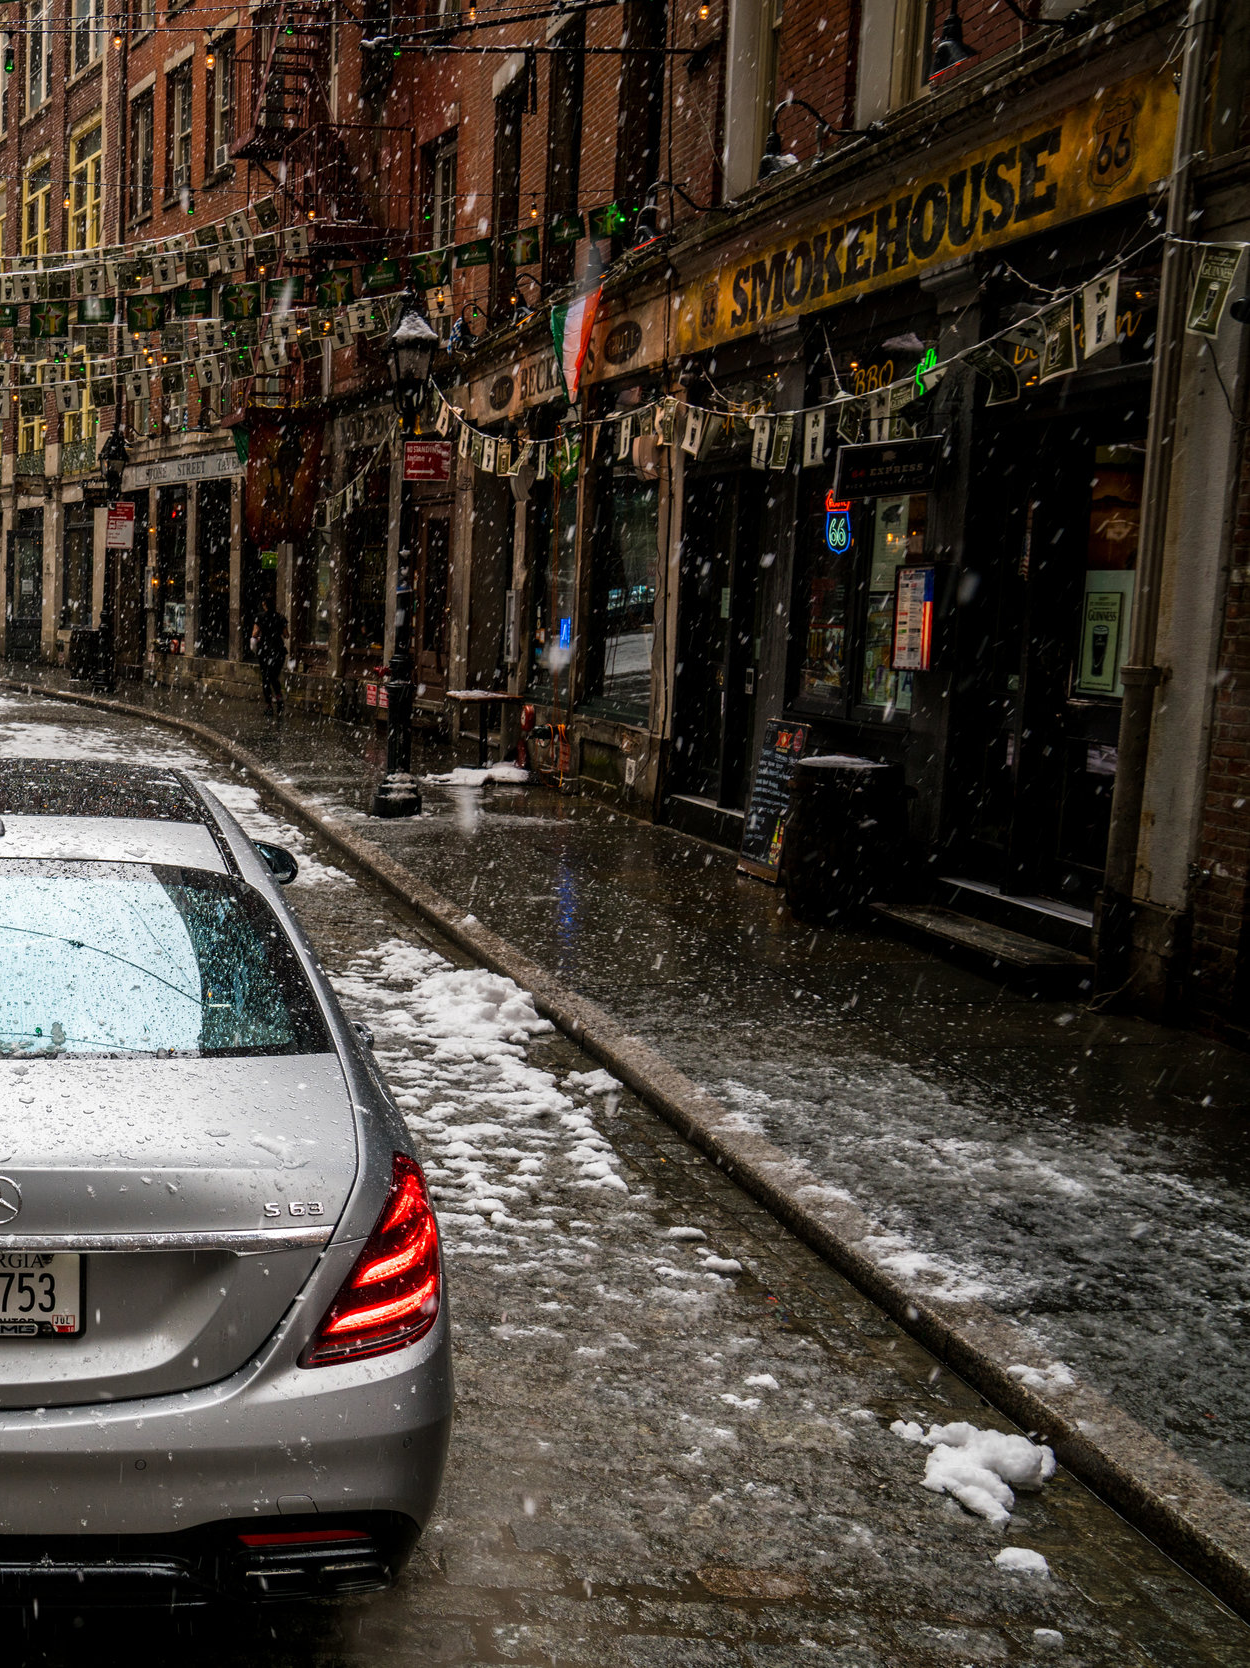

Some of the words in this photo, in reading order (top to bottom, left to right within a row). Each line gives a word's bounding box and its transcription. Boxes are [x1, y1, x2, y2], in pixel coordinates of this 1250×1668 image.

[1097, 123, 1131, 175] 66
[730, 126, 1062, 329] SMOKEHOUSE
[702, 299, 716, 329] 66
[406, 445, 414, 454] NO
[413, 445, 443, 455] STANDING
[177, 461, 206, 477] STREET
[216, 455, 241, 472] TAVE
[869, 462, 924, 478] EXPRESS
[828, 517, 847, 547] 66
[1088, 609, 1117, 622] GUINNESS
[263, 1202, 281, 1217] S
[288, 1201, 324, 1217] 63
[54, 1315, 71, 1325] JUL
